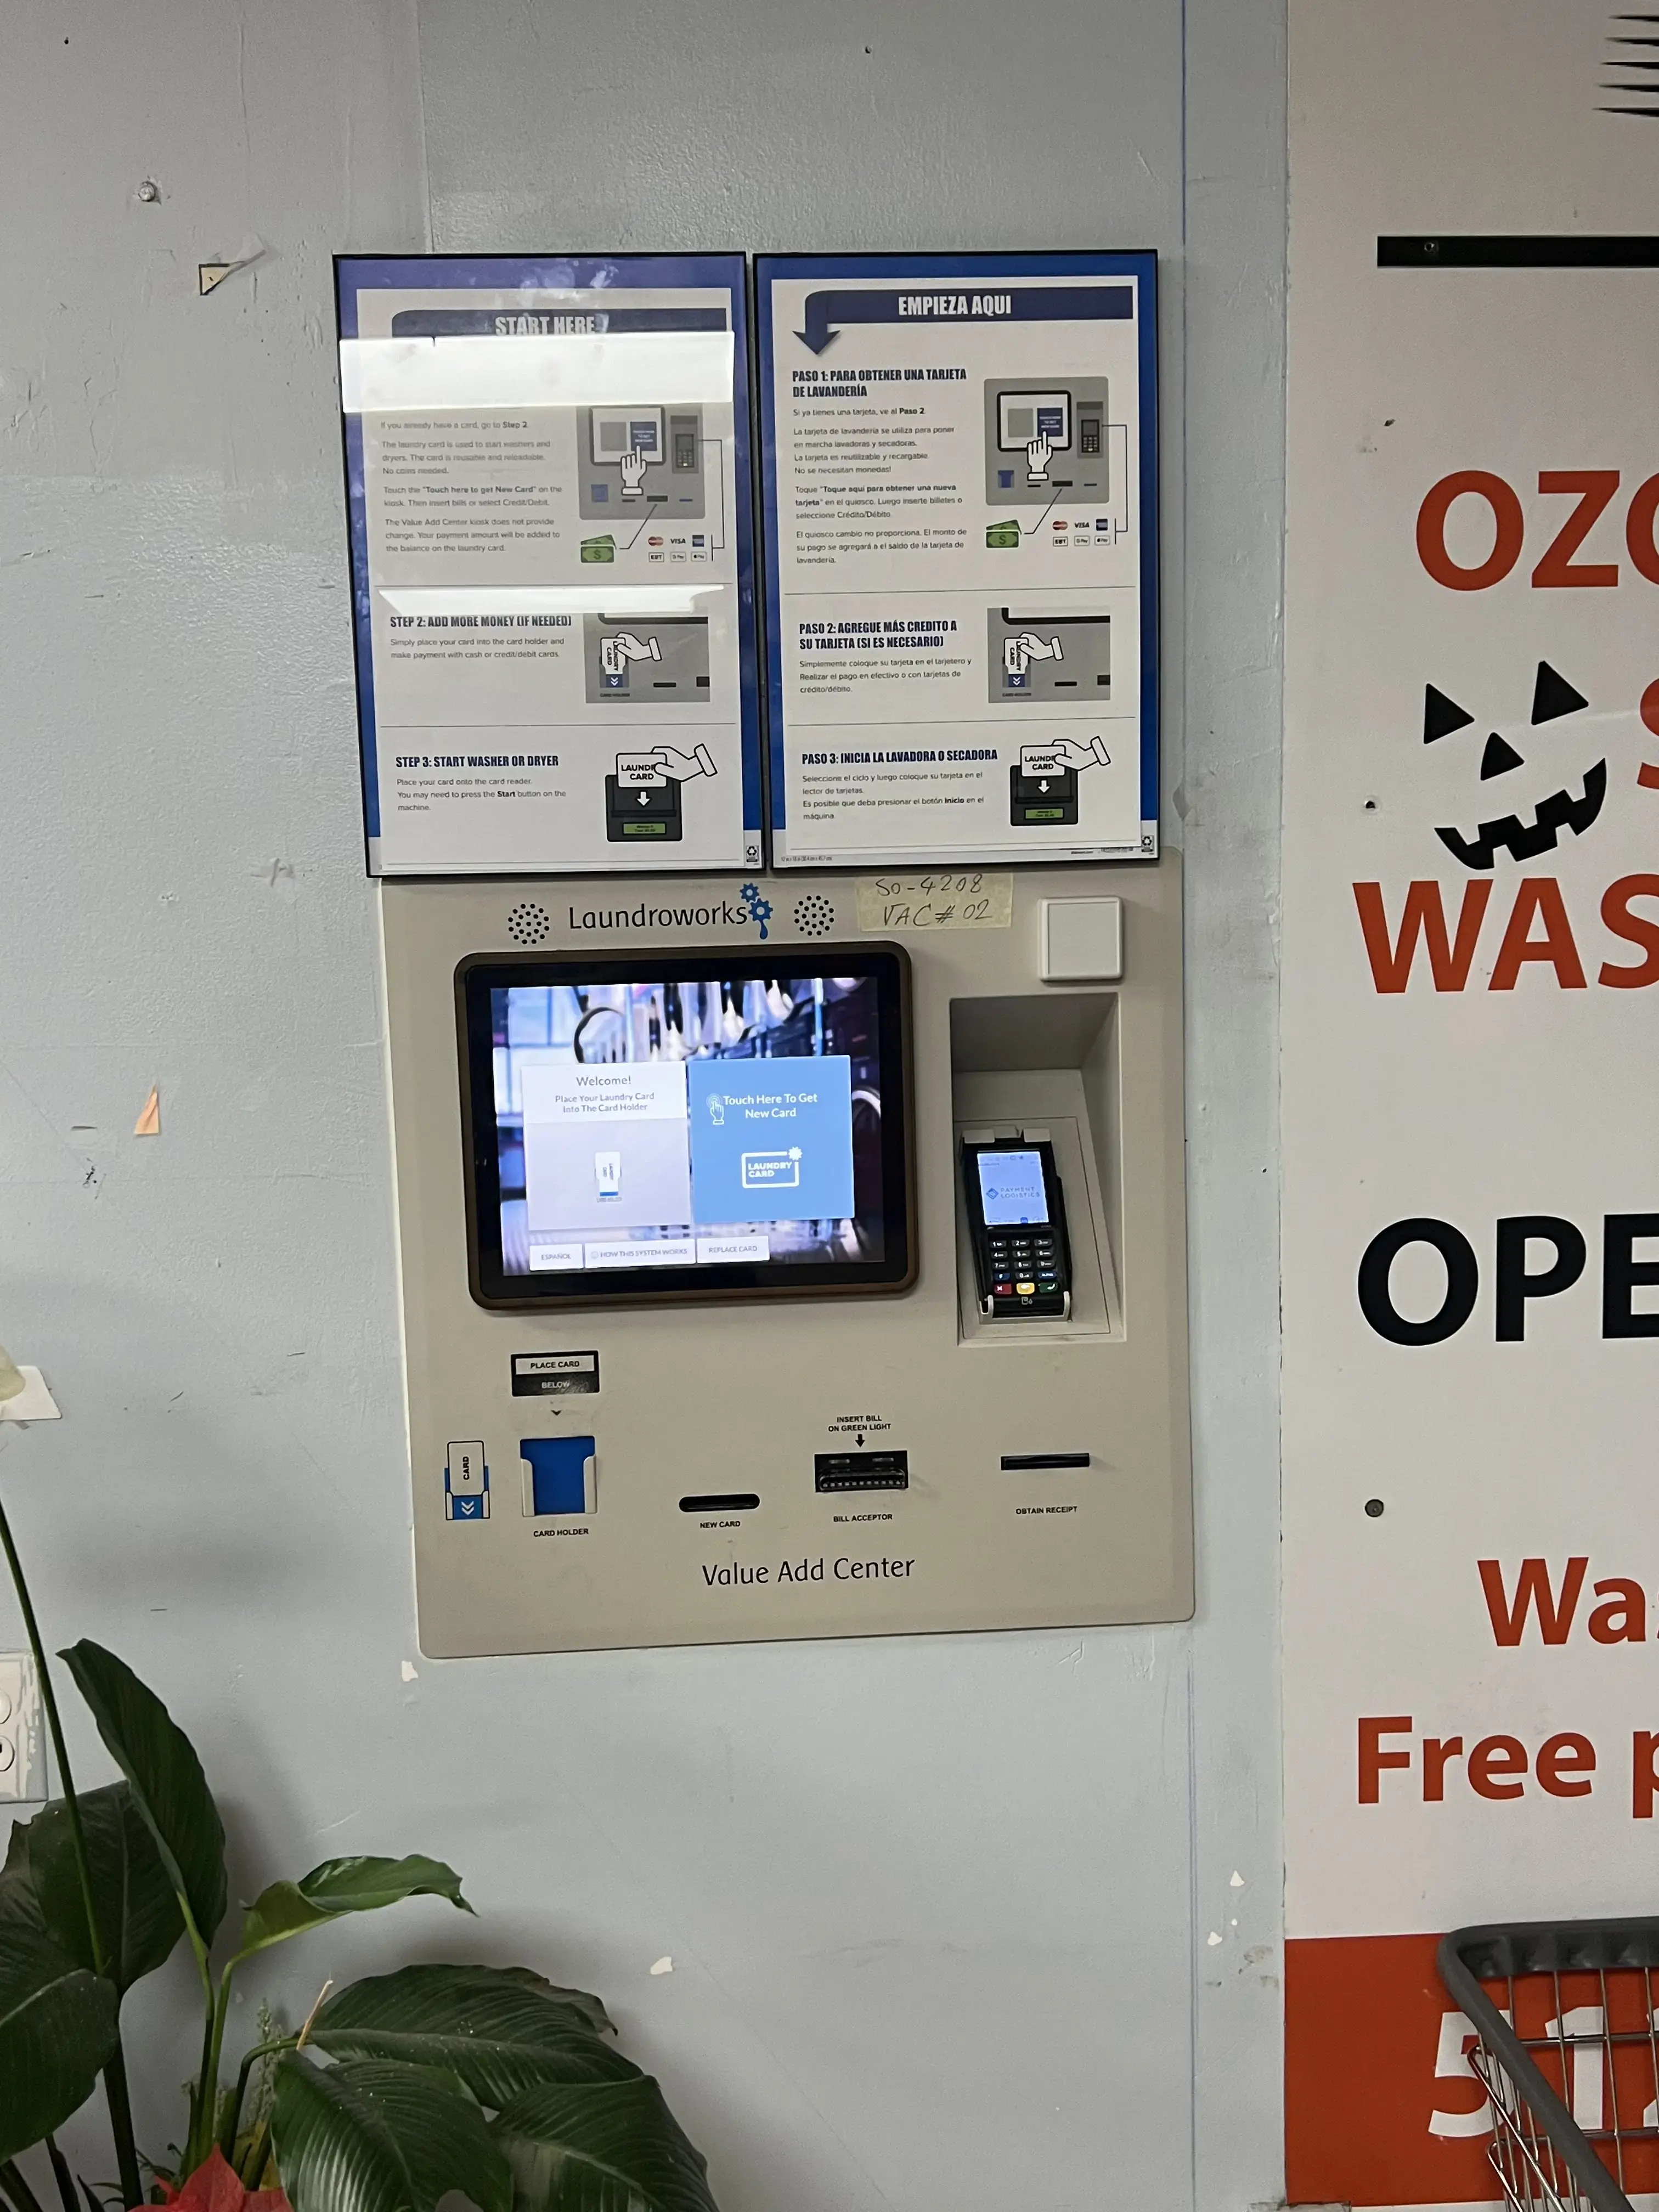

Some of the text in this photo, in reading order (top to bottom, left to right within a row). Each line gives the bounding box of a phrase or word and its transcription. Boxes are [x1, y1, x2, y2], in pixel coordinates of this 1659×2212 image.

[898, 295, 1011, 315] EMPIEZA AQUI
[495, 316, 595, 336] START HERE
[792, 368, 967, 382] PASO 1: PARA OBTENER UNA TARJETA
[792, 383, 867, 397] DE LAVANDERÍA
[390, 615, 572, 628] STEP 2: ADD MORE MONEY (IF NEEDED)
[799, 619, 957, 634] PASO 2: AGREGUE MÁS CREDITO A
[799, 635, 944, 650] SU TARJETA (SI ES NECESARIO)
[395, 755, 558, 768] STEP 3: START WASHER OR DRYER
[802, 749, 998, 764] PASO 3: INICIA LA LAVADORA O SECADORA
[569, 901, 748, 929] Laundroworks
[575, 1075, 631, 1086] Welcome!
[554, 1094, 577, 1103] Place
[599, 1093, 633, 1102] Laundry
[634, 1092, 654, 1100] Card
[723, 1092, 817, 1105] Touch Here To Get
[562, 1105, 580, 1113] Into
[597, 1103, 618, 1112] Card
[619, 1103, 648, 1111] Holder
[744, 1107, 797, 1119] New Card
[718, 1520, 741, 1528] CARD
[850, 1513, 893, 1521] ACCEPTOR
[556, 1527, 589, 1536] HOLDER
[701, 1557, 915, 1585] Value Add Center
[1477, 1557, 1659, 1646] Wa
[1358, 1716, 1596, 1804] Free
[1428, 2005, 1659, 2137] 51
